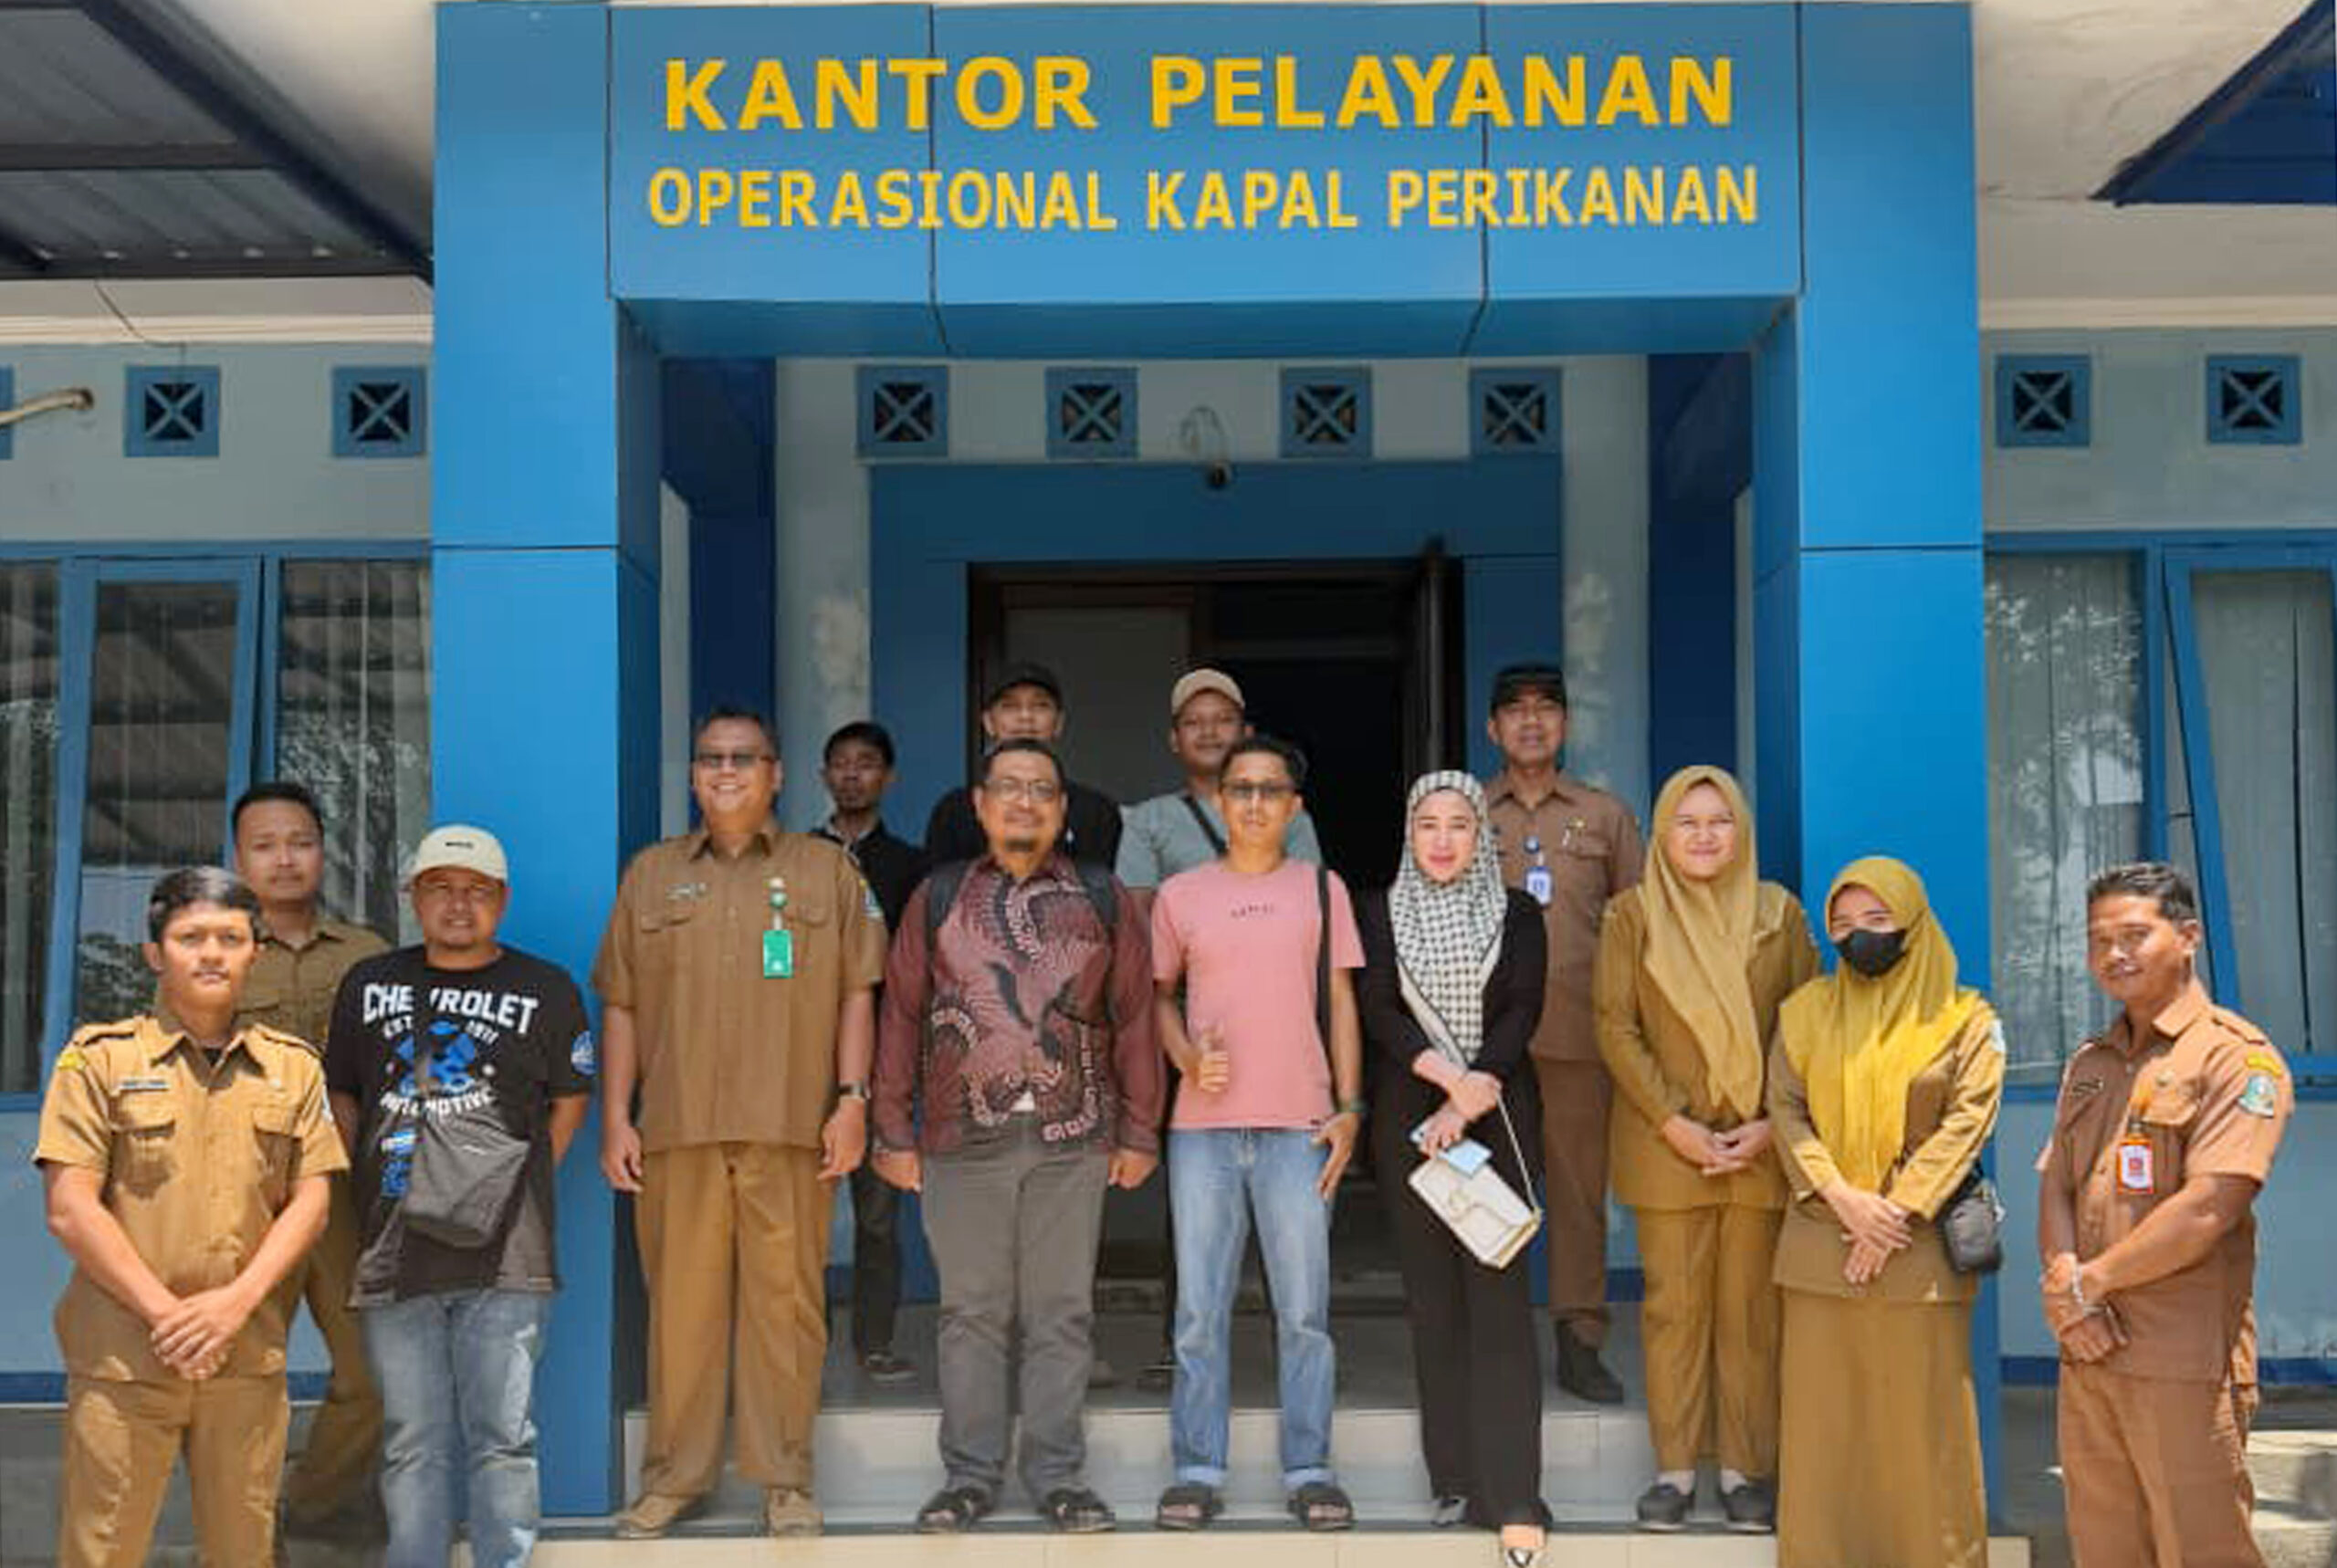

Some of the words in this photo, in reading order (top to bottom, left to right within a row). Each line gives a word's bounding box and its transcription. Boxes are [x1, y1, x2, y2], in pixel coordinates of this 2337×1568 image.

[665, 56, 1098, 131] KANTOR
[1149, 54, 1733, 129] PELAYANAN
[648, 166, 1117, 231] OPERASIONAL
[1147, 169, 1358, 231] KAPAL
[1387, 165, 1758, 229] PERIKANAN
